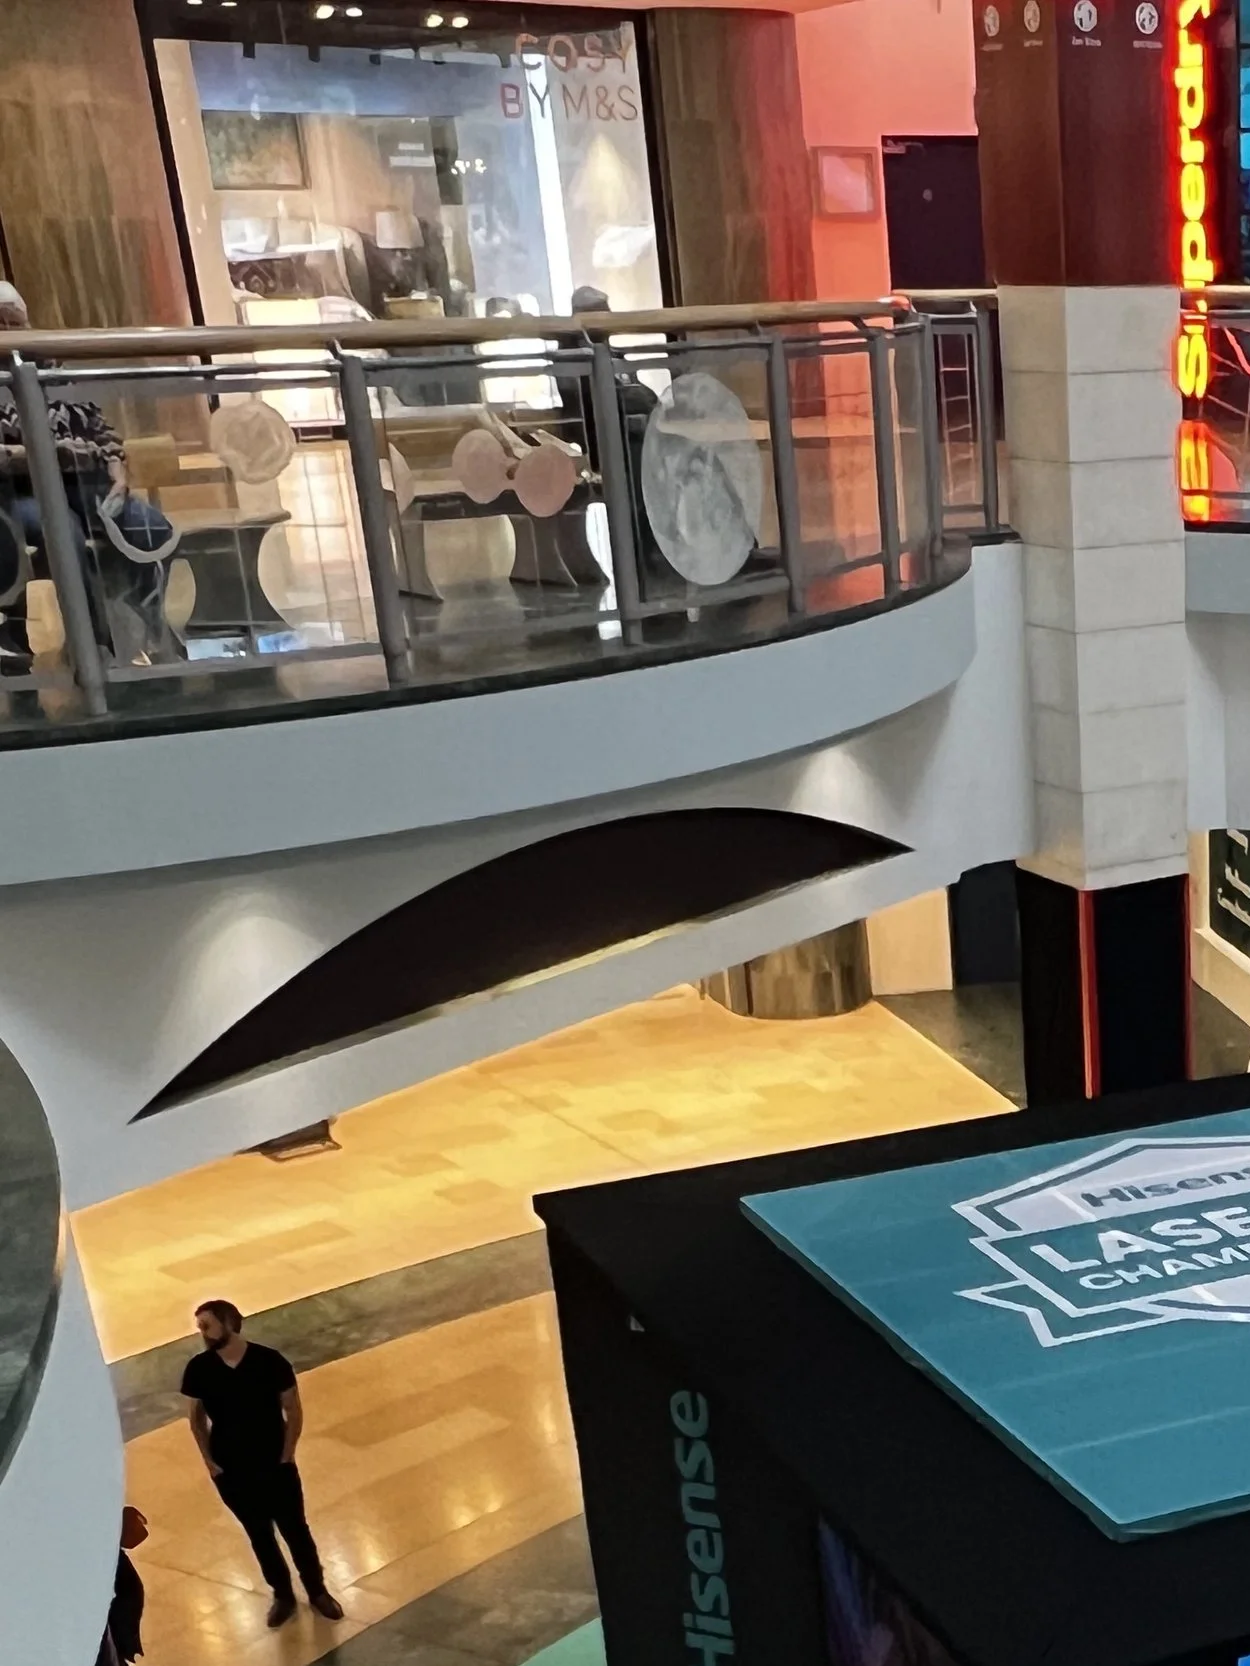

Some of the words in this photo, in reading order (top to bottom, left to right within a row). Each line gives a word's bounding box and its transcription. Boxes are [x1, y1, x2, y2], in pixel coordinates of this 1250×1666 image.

[515, 32, 632, 74] COSY
[500, 83, 550, 119] BY
[562, 84, 638, 121] M&S
